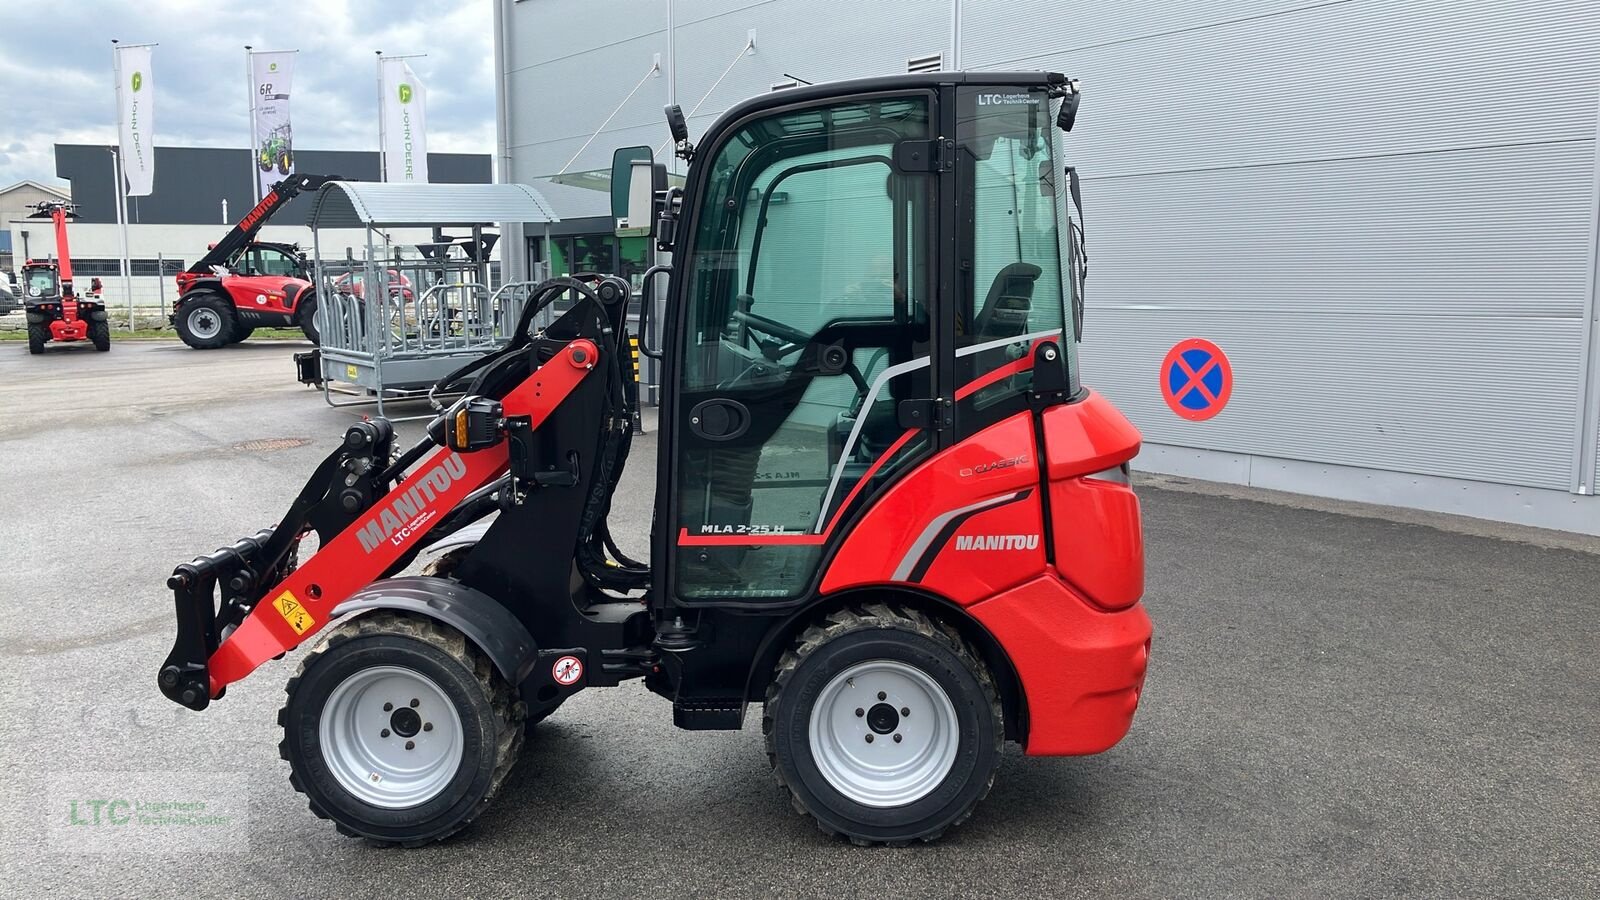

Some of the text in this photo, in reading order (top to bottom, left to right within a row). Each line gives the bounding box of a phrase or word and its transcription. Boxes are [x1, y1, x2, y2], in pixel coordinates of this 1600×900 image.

[260, 83, 273, 95] 6R
[978, 94, 1002, 105] LTC
[403, 108, 414, 180] JOHN DEERE
[240, 191, 279, 232] MANITOU
[975, 455, 1030, 473] CLASSIC
[355, 452, 467, 555] MANITOU
[391, 527, 411, 546] LTC
[701, 524, 785, 534] MLA 2-25 H
[955, 535, 1039, 551] MANITOU
